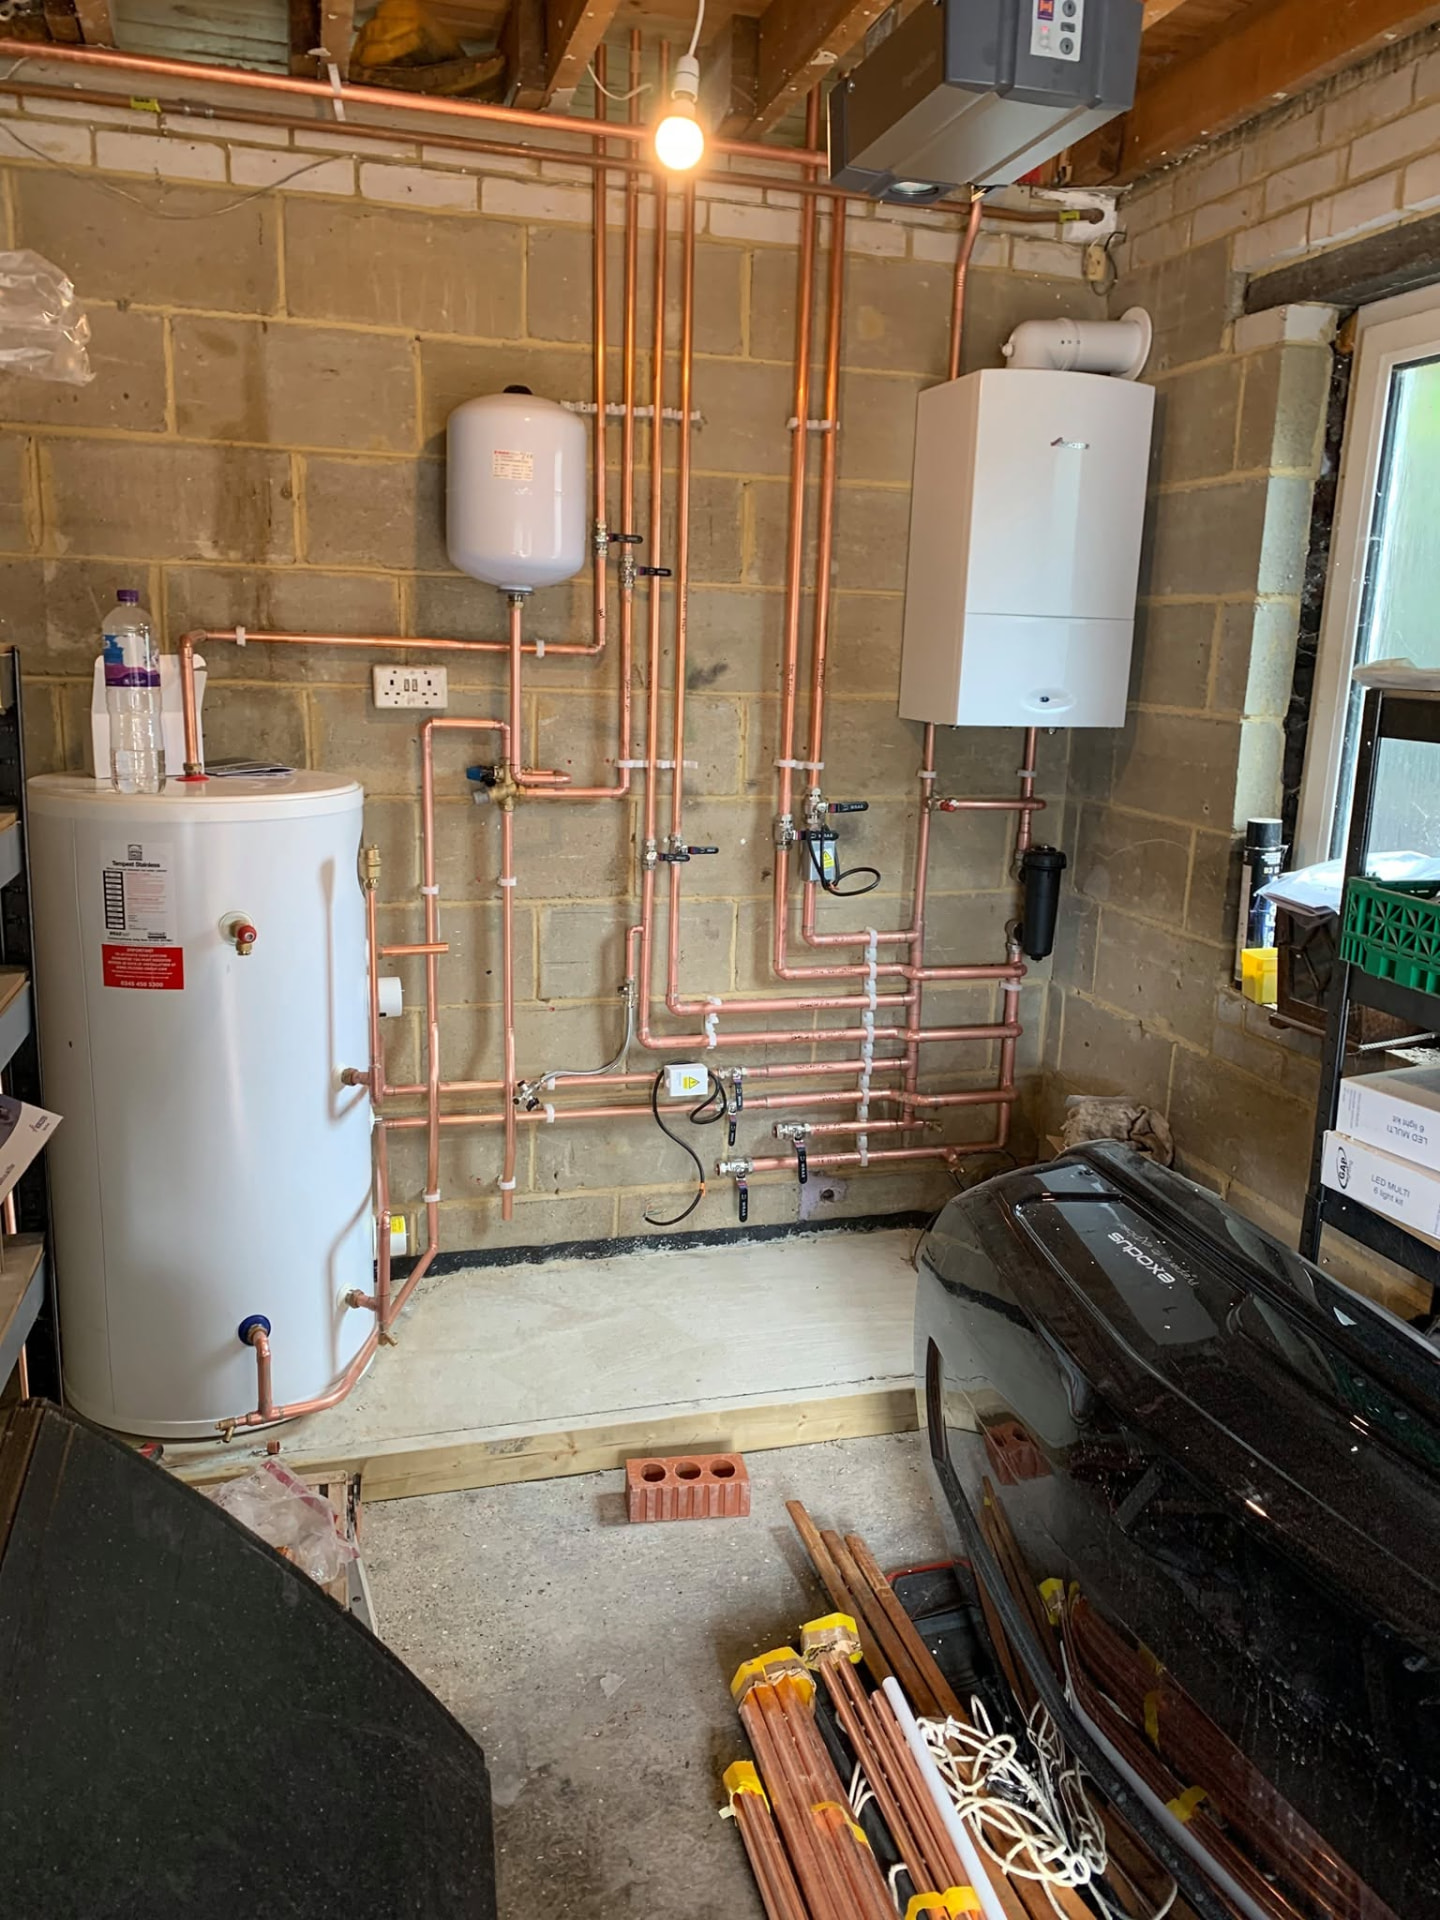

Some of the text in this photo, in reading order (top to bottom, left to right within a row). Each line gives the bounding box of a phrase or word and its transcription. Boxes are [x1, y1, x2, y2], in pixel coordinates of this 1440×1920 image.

[112, 860, 134, 868] Tempest
[1386, 1124, 1428, 1145] LED MULTI
[1419, 1125, 1425, 1133] 6
[1371, 1174, 1411, 1198] LED MULTI
[1373, 1186, 1379, 1195] 6
[1107, 1231, 1176, 1284] exodus
